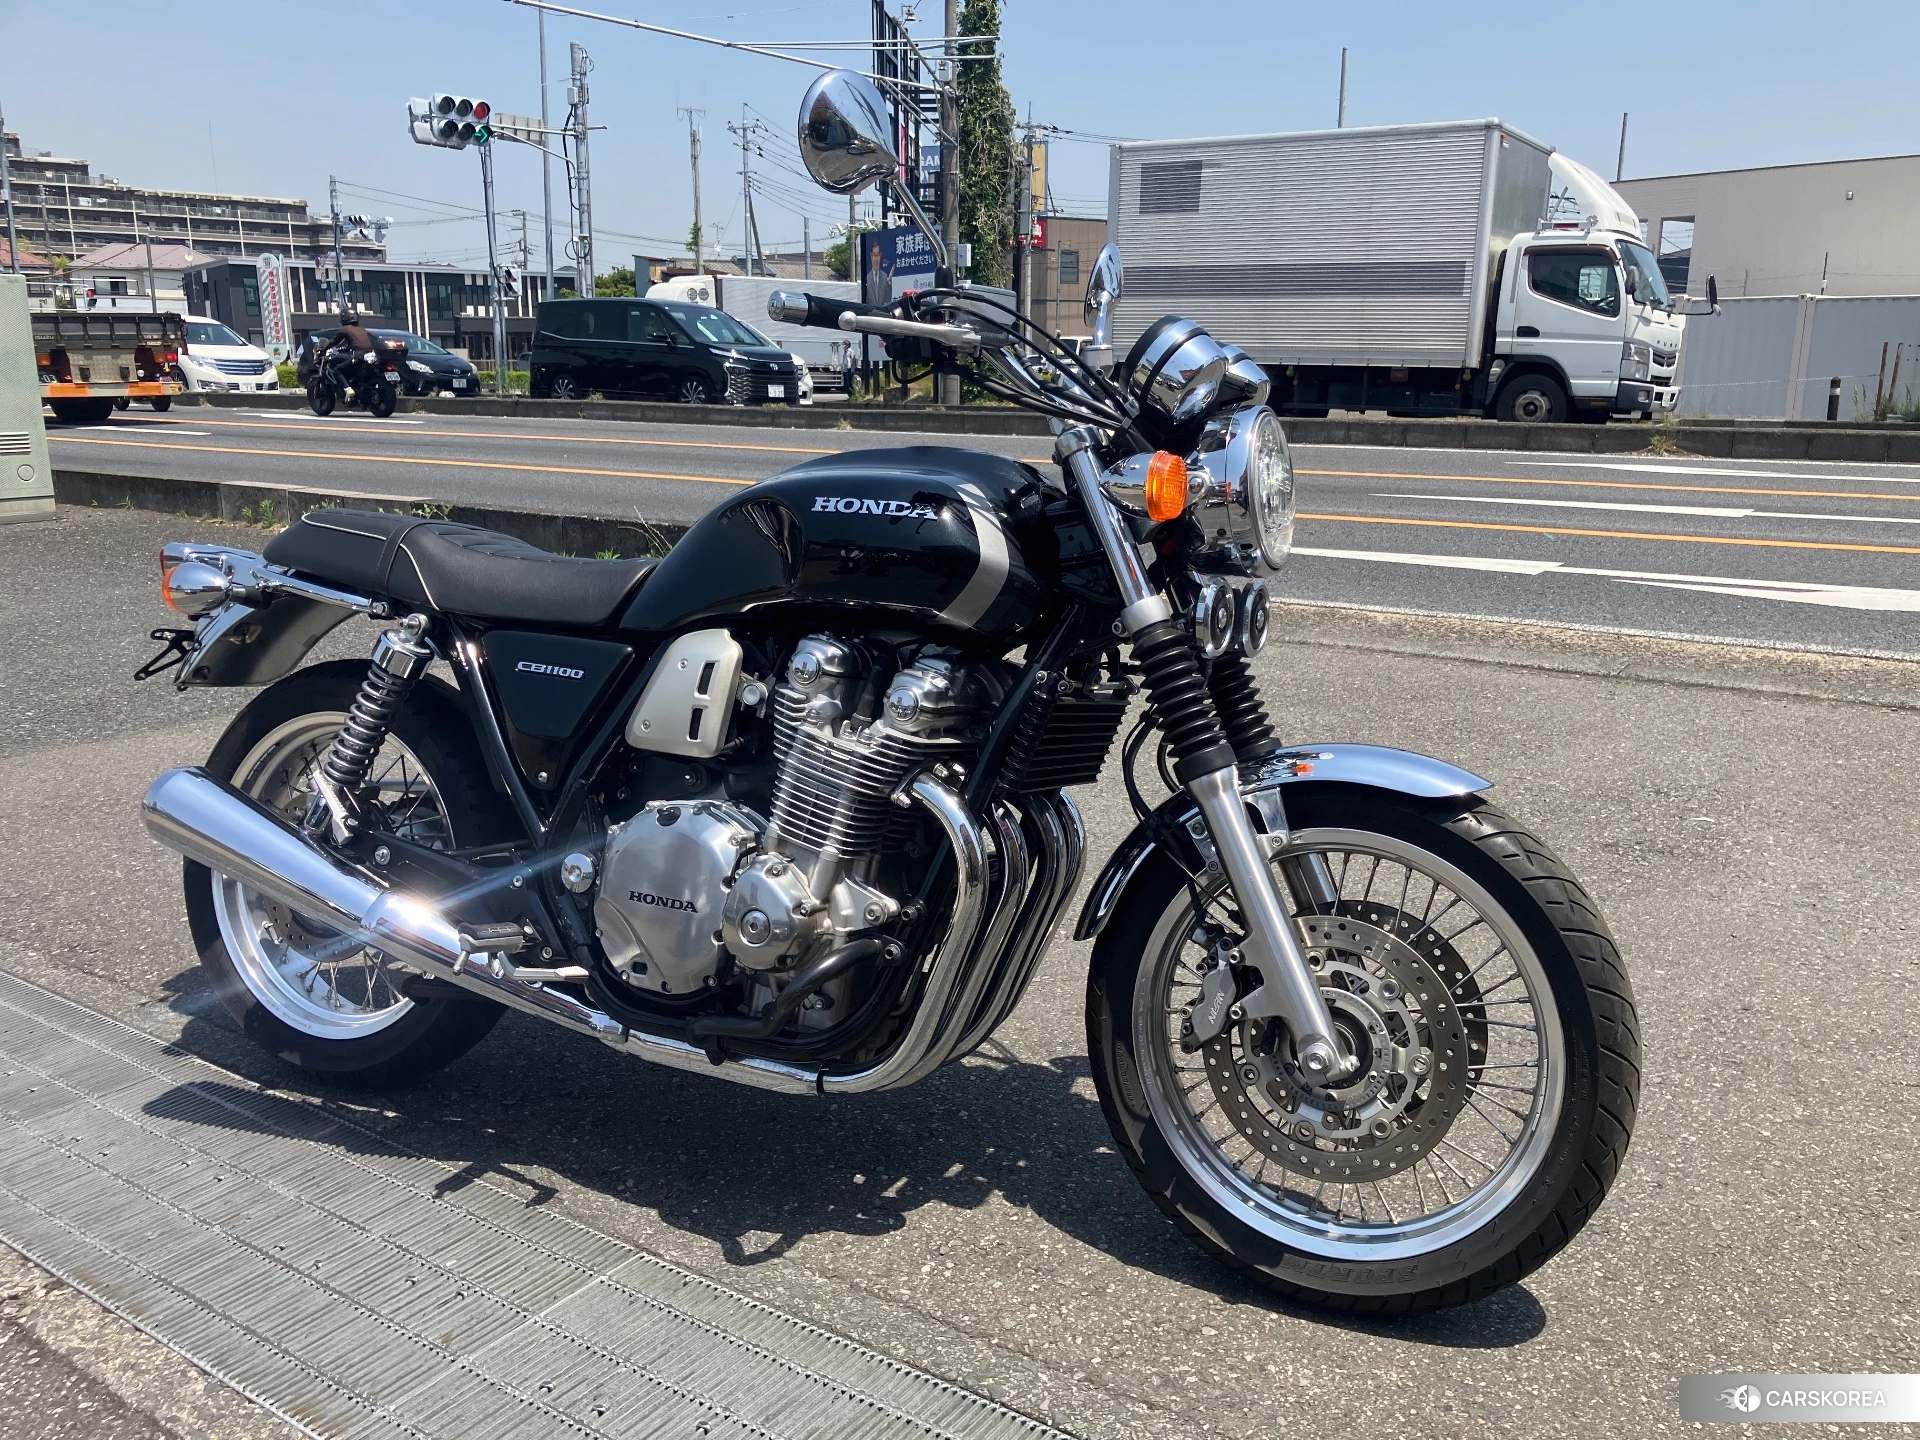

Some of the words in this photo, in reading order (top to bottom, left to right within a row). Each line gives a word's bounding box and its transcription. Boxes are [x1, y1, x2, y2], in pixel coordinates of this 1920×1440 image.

[896, 232, 931, 255] 家族葬は
[896, 255, 935, 268] おまかせください
[811, 496, 938, 520] HONDA
[517, 661, 584, 679] CB1100
[628, 890, 699, 914] HONDA
